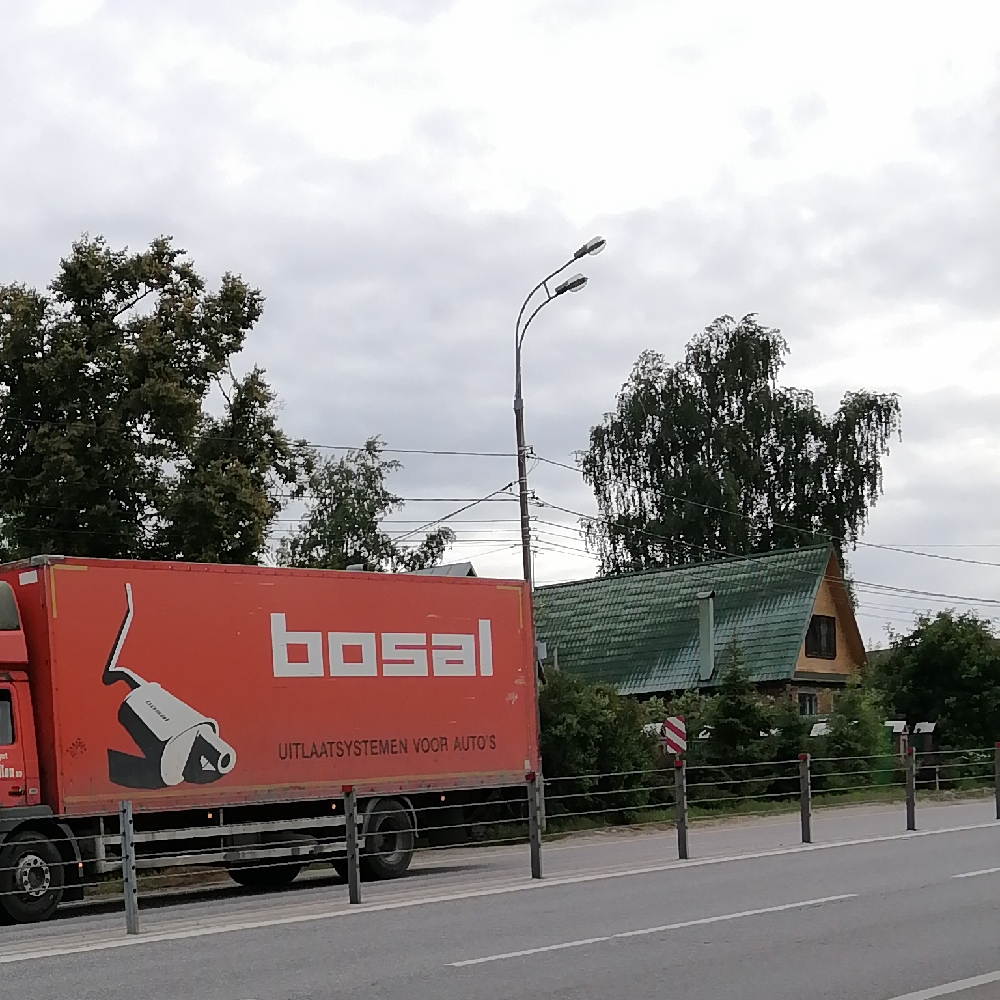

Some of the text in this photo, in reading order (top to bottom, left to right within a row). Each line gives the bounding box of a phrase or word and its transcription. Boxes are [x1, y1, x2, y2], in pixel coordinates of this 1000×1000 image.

[270, 613, 494, 677] bosal
[279, 734, 497, 760] UITLAATSYSTEMEN VOOR AUTO'S
